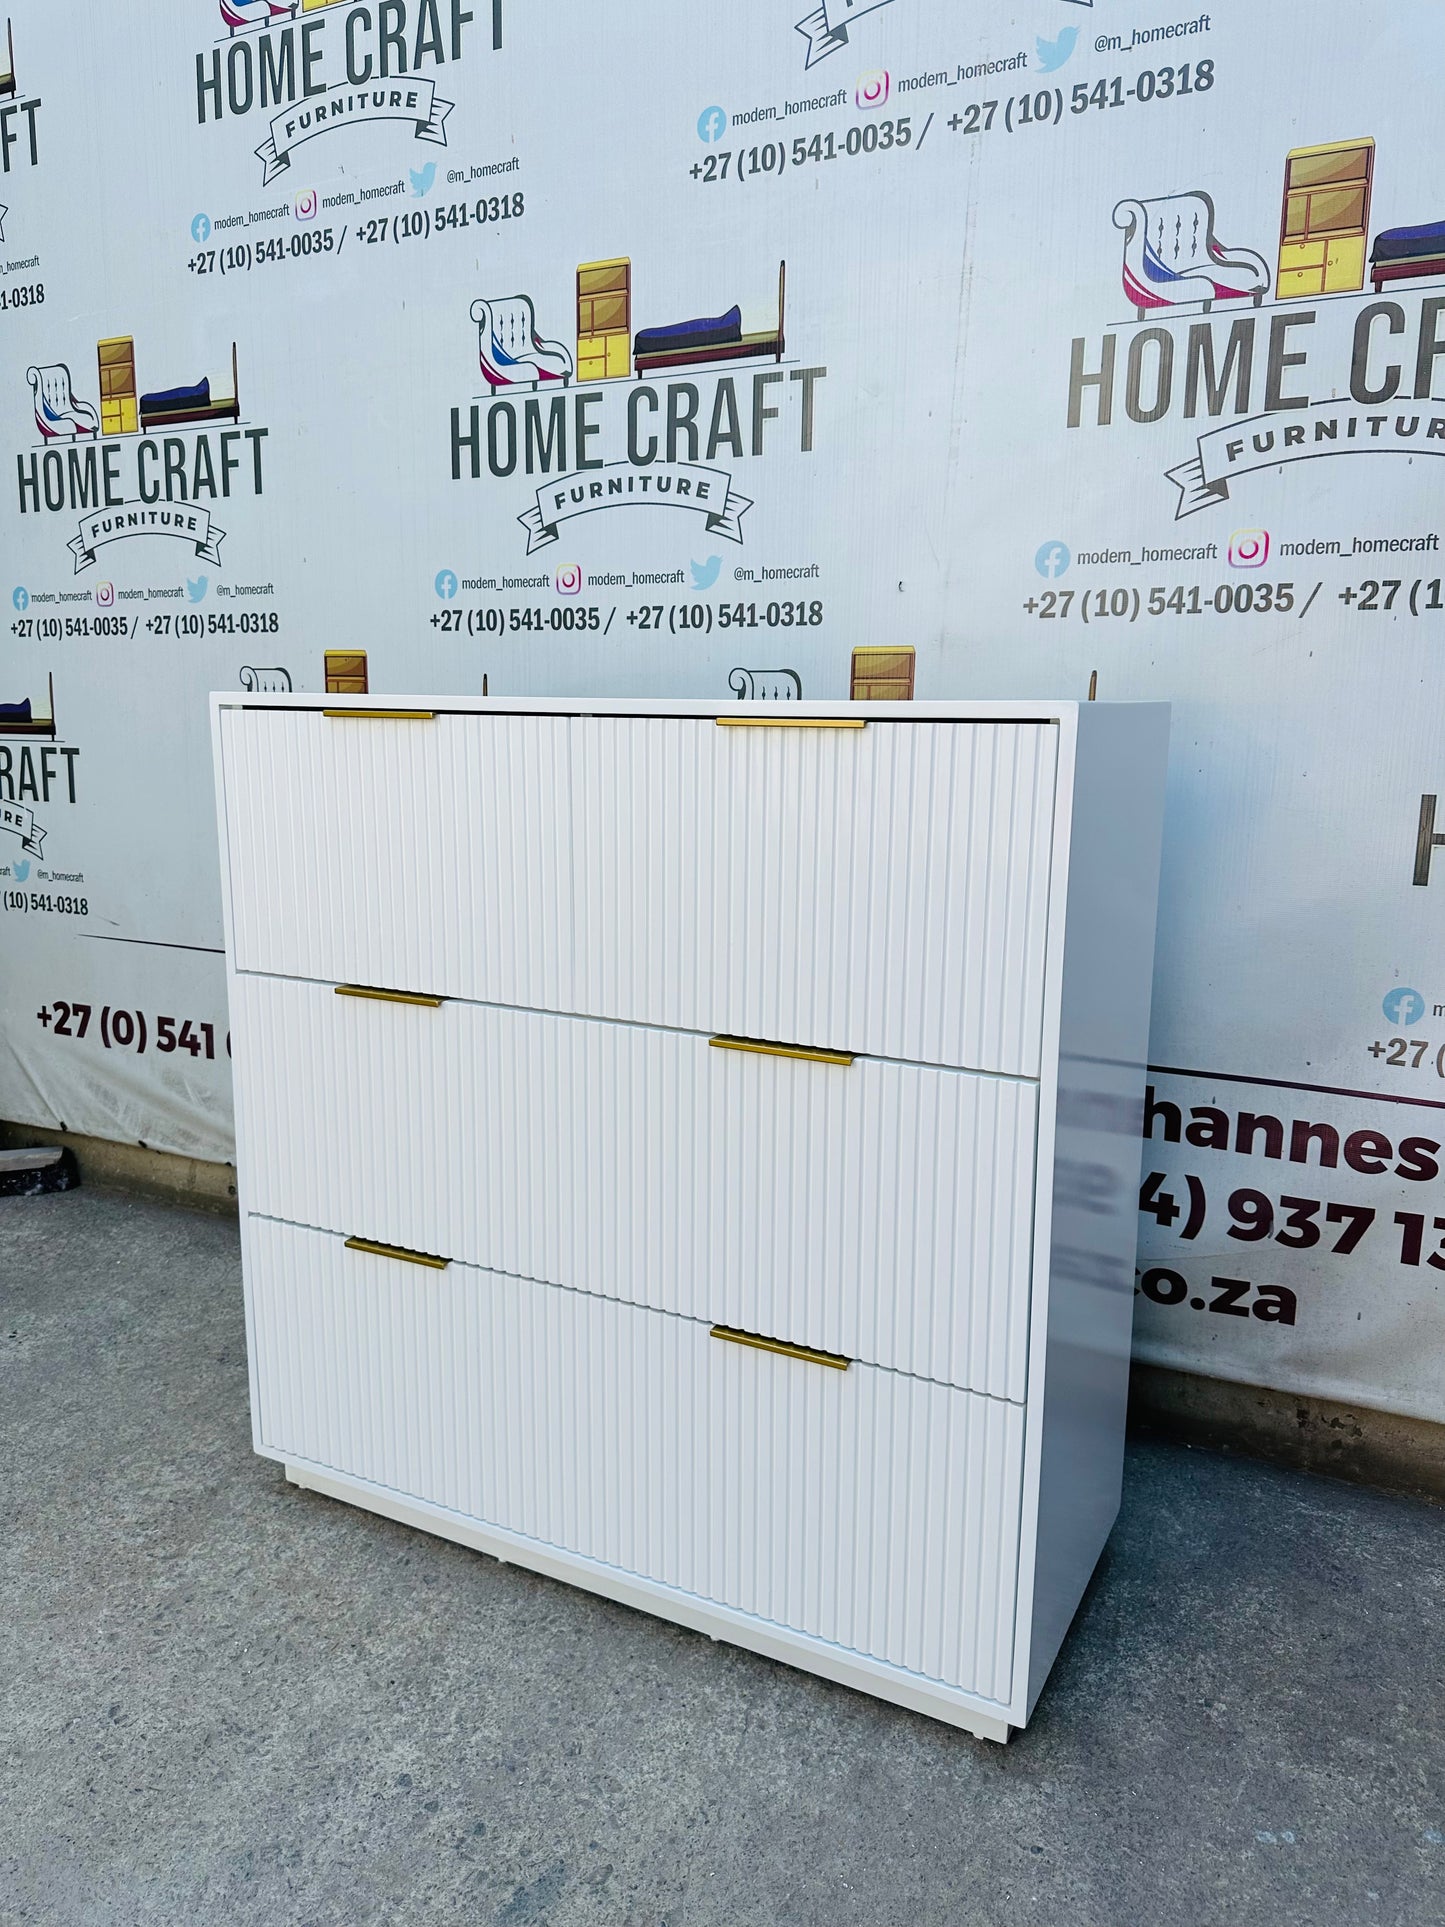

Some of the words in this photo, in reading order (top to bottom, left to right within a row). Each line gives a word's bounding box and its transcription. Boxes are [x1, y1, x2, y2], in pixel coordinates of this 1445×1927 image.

[1095, 14, 1211, 52] @m_homecraft
[195, 18, 327, 124] HOME
[285, 91, 418, 138] FURNITURE
[689, 152, 732, 183] +27
[737, 142, 785, 182] (10)
[792, 117, 911, 166] 541-0035
[947, 100, 998, 135] +27
[1005, 88, 1063, 133] (10)
[1070, 59, 1214, 114] 541-0318
[447, 157, 520, 183] @m_homecraft
[188, 250, 215, 275] +27
[220, 244, 252, 275] (10)
[256, 228, 334, 264] 541-0035
[356, 218, 388, 244] +27
[393, 210, 430, 244] (10)
[435, 192, 525, 231] 541-0318
[1067, 311, 1316, 428] HOME
[450, 392, 603, 480] HOME
[627, 367, 827, 467] CRAFT
[17, 444, 124, 514] HOME
[137, 428, 269, 504] CRAFT
[553, 475, 711, 510] FURNITURE
[91, 511, 197, 538] FURNITURE
[216, 583, 274, 598] @m_homecraft
[734, 563, 819, 583] @m_homecraft
[430, 610, 463, 631] +27
[468, 609, 505, 636] (10)
[509, 607, 600, 631] 541-0035
[626, 605, 664, 629] +27
[669, 604, 712, 634] (10)
[718, 601, 823, 628] 541-0318
[1023, 591, 1075, 619] +27
[1081, 588, 1140, 624] (10)
[1147, 583, 1294, 615] 541-0035
[1338, 580, 1402, 610] +27
[11, 619, 33, 637] +27
[37, 618, 62, 641] (10)
[66, 617, 128, 636] 541-0035
[146, 615, 171, 634] +27
[175, 614, 204, 639] (10)
[208, 612, 279, 634] 541-0318
[4, 891, 28, 913] (10)
[31, 893, 88, 916] 541-0318
[37, 1001, 91, 1038] +27
[101, 1006, 147, 1054] (0)
[156, 1016, 215, 1060] 541
[1367, 1038, 1429, 1068] +27
[1226, 1188, 1376, 1255] 937
[1135, 1266, 1297, 1326] o.za
